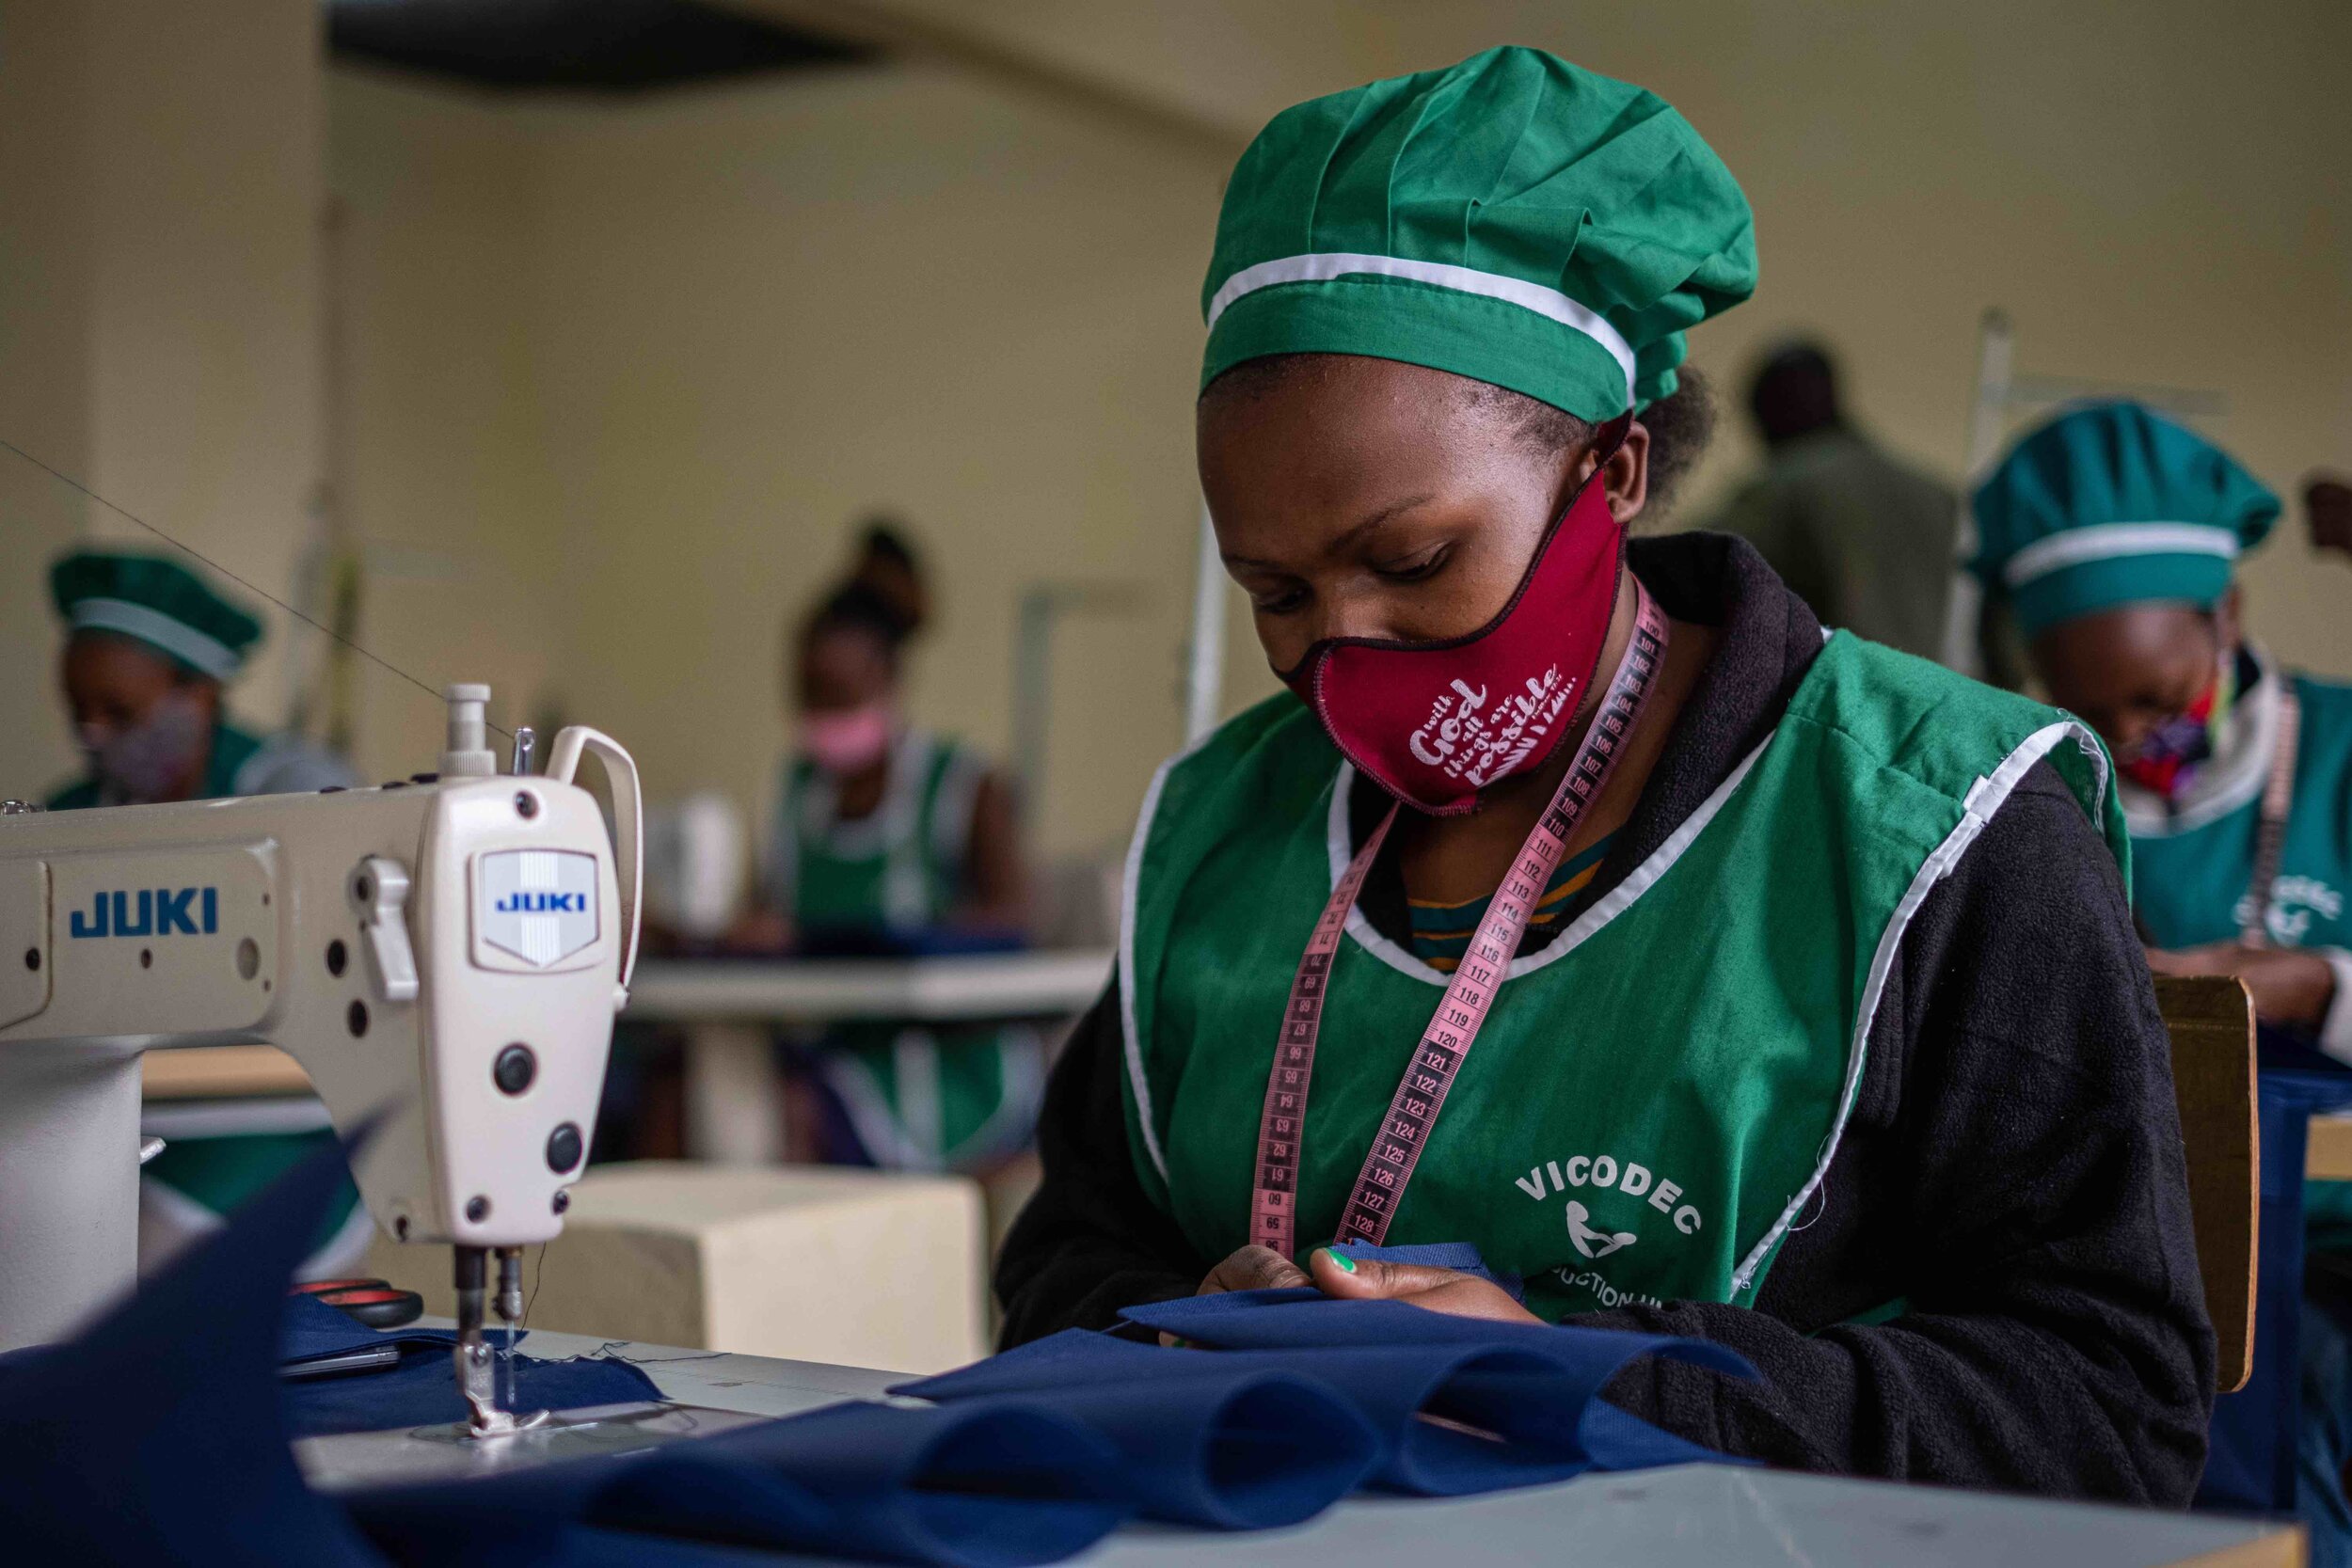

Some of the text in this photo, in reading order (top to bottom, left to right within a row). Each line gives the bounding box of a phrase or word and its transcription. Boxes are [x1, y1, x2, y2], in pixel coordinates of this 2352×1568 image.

[1640, 637, 1656, 654] 101
[1634, 656, 1650, 673] 102
[1626, 674, 1642, 693] 103
[1490, 694, 1513, 724] are
[1616, 694, 1632, 712] 104
[1409, 678, 1486, 766] God
[1423, 695, 1454, 731] with
[1462, 716, 1484, 742] all
[1464, 663, 1557, 786] possible
[1605, 715, 1623, 734] 105
[1595, 736, 1613, 753] 106
[1443, 731, 1492, 779] things
[1583, 755, 1602, 773] 107
[1573, 776, 1590, 795] 108
[1561, 797, 1579, 816] 109
[1548, 818, 1565, 836] 110
[1536, 839, 1552, 855] 111
[1524, 860, 1541, 879] 112
[1513, 881, 1530, 899] 113
[496, 892, 585, 912] JUKI
[1502, 902, 1519, 921] 114
[71, 887, 217, 939] JUKI
[1490, 924, 1509, 941] 115
[1481, 944, 1500, 962] 116
[1470, 965, 1491, 983] 117
[1460, 987, 1479, 1006] 118
[1449, 1009, 1469, 1026] 119
[1438, 1031, 1458, 1048] 120
[1426, 1052, 1447, 1069] 121
[1416, 1074, 1437, 1093] 122
[1405, 1098, 1426, 1117] 123
[1394, 1121, 1416, 1139] 124
[1384, 1144, 1406, 1163] 125
[1374, 1167, 1394, 1186] 126
[1363, 1191, 1385, 1209] 127
[1515, 1155, 1702, 1235] VICODEC
[1355, 1214, 1375, 1233] 128
[1550, 1266, 1634, 1307] UCTION
